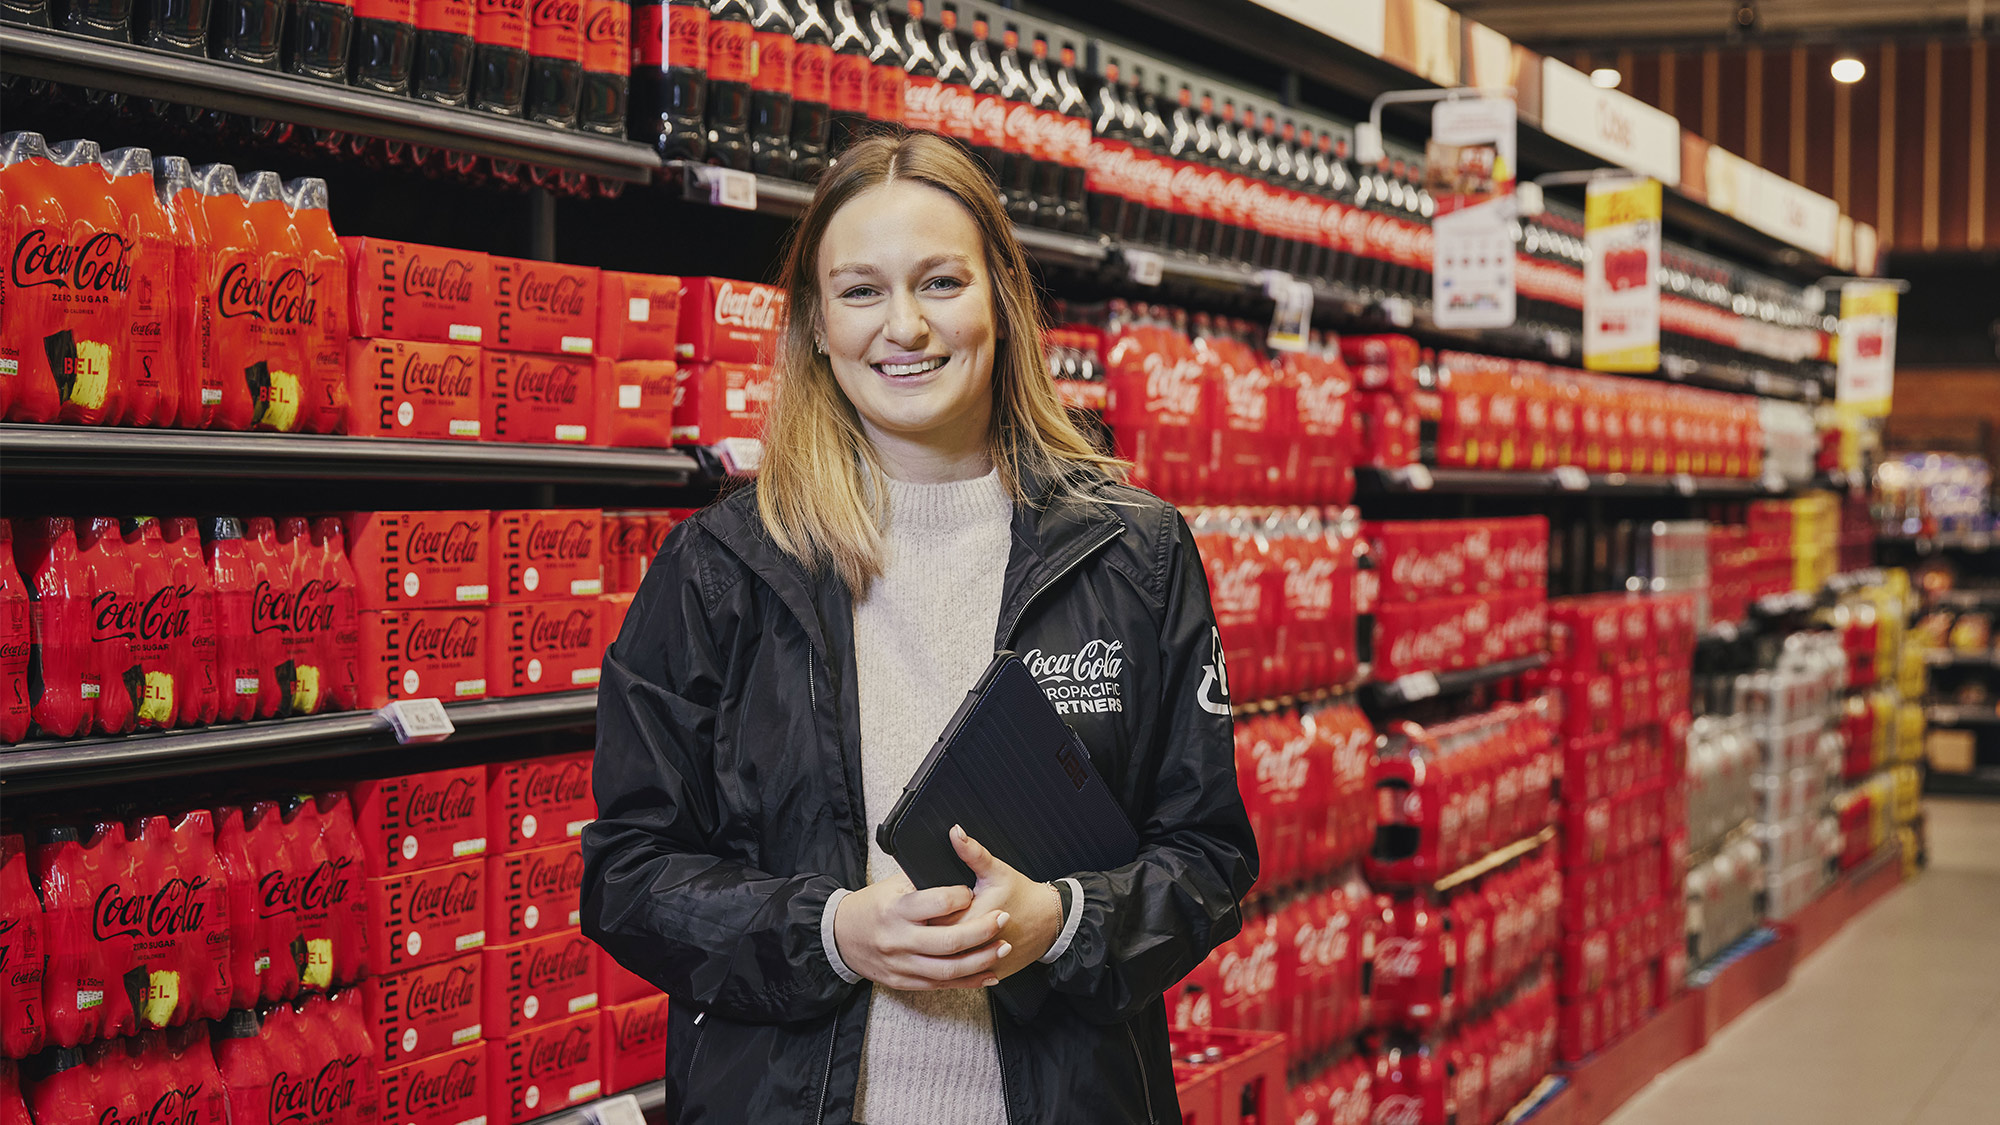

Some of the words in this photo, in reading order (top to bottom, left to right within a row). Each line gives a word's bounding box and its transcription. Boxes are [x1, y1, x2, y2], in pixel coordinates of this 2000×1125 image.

[12, 230, 135, 292] Coca-Cola
[52, 294, 72, 302] ZERO
[75, 295, 109, 303] SUGAR
[219, 263, 323, 326] Coca-Cola
[378, 248, 395, 331] mini
[495, 265, 510, 343] mini
[64, 357, 99, 375] BEL
[260, 386, 290, 403] BEL
[375, 347, 394, 430] mini
[491, 357, 507, 435] mini
[381, 519, 398, 601] mini
[504, 518, 519, 595] mini
[91, 584, 196, 642] Coca-Cola
[252, 579, 341, 635] Coca-Cola
[381, 617, 399, 700] mini
[509, 611, 523, 688] mini
[1023, 638, 1123, 684] Coca-Cola
[1043, 682, 1120, 701] ROPACIFIC
[1055, 698, 1122, 714] RTNERS
[381, 785, 398, 868] mini
[505, 768, 519, 845] mini
[93, 875, 211, 942] Coca-Cola
[505, 860, 521, 936] mini
[527, 851, 584, 899] Coca-Col
[149, 940, 175, 949] SUGAR
[385, 882, 402, 964] mini
[380, 980, 398, 1062] mini
[507, 950, 521, 1027] mini
[382, 1075, 398, 1125] ini
[506, 1041, 521, 1117] mini
